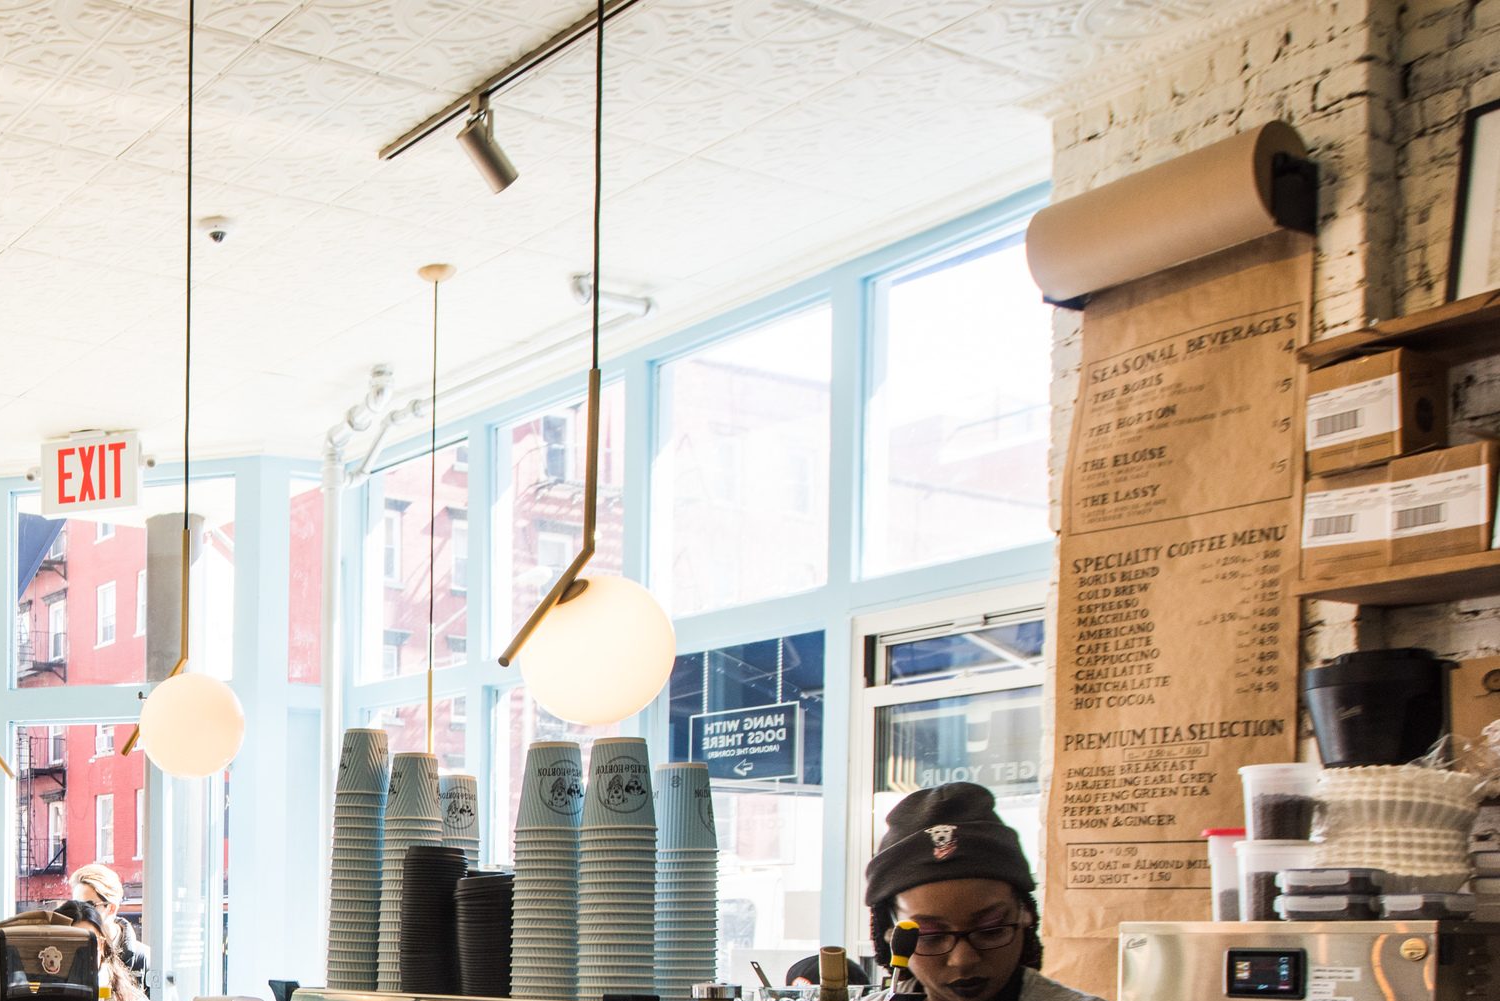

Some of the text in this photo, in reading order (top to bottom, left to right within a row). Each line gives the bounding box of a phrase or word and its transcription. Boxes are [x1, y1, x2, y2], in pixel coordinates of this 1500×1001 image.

[1090, 344, 1179, 386] SEASONAL
[1185, 312, 1298, 354] BEVERAGES
[1092, 388, 1117, 404] THE
[1121, 373, 1164, 395] BORIS
[1088, 421, 1113, 438] THE
[1116, 404, 1178, 430] HORTON
[1080, 459, 1108, 474] THE
[1112, 445, 1167, 468] ELOISE
[57, 442, 126, 504] EXIT
[1081, 493, 1109, 508] THE
[1114, 484, 1161, 503] LASSY
[1072, 524, 1288, 574] SPECIALTY COFFEE MENU
[1079, 572, 1117, 588] BORIS
[1119, 566, 1160, 582] BLEND
[1077, 588, 1112, 602] COLD
[1113, 582, 1151, 598] BREW
[1077, 598, 1140, 615] ESPRESSO
[1077, 608, 1150, 627] MACCHIATO
[1077, 621, 1155, 642] AMERICANO
[1075, 642, 1111, 655] CAFE
[1114, 636, 1154, 651] LATTE
[1075, 648, 1160, 667] CAPPUCCINO
[1074, 667, 1110, 681] CHAI
[1113, 663, 1154, 678] LATTE
[1074, 681, 1129, 695] MATCHA
[1131, 675, 1171, 690] LATTE
[1075, 697, 1104, 710] HOT
[1107, 694, 1156, 708] COCOA
[1063, 718, 1285, 751] PREMIUM TEA SELECTION
[1067, 759, 1197, 779] ENGLISH BREAKFAST
[1065, 772, 1218, 791] DARJEELING EARL GREY
[1064, 784, 1211, 804] MAO FENG GREEN TEA
[1062, 802, 1149, 818] PEPPERMINT
[1062, 817, 1109, 830] LEMON
[1124, 814, 1177, 827] GINGER
[1070, 847, 1098, 858] ICED
[1098, 860, 1119, 871] OAT
[1134, 859, 1184, 870] ALMOND
[1186, 858, 1212, 870] MIL
[1072, 873, 1095, 884] ADD
[1100, 873, 1130, 885] SHOT
